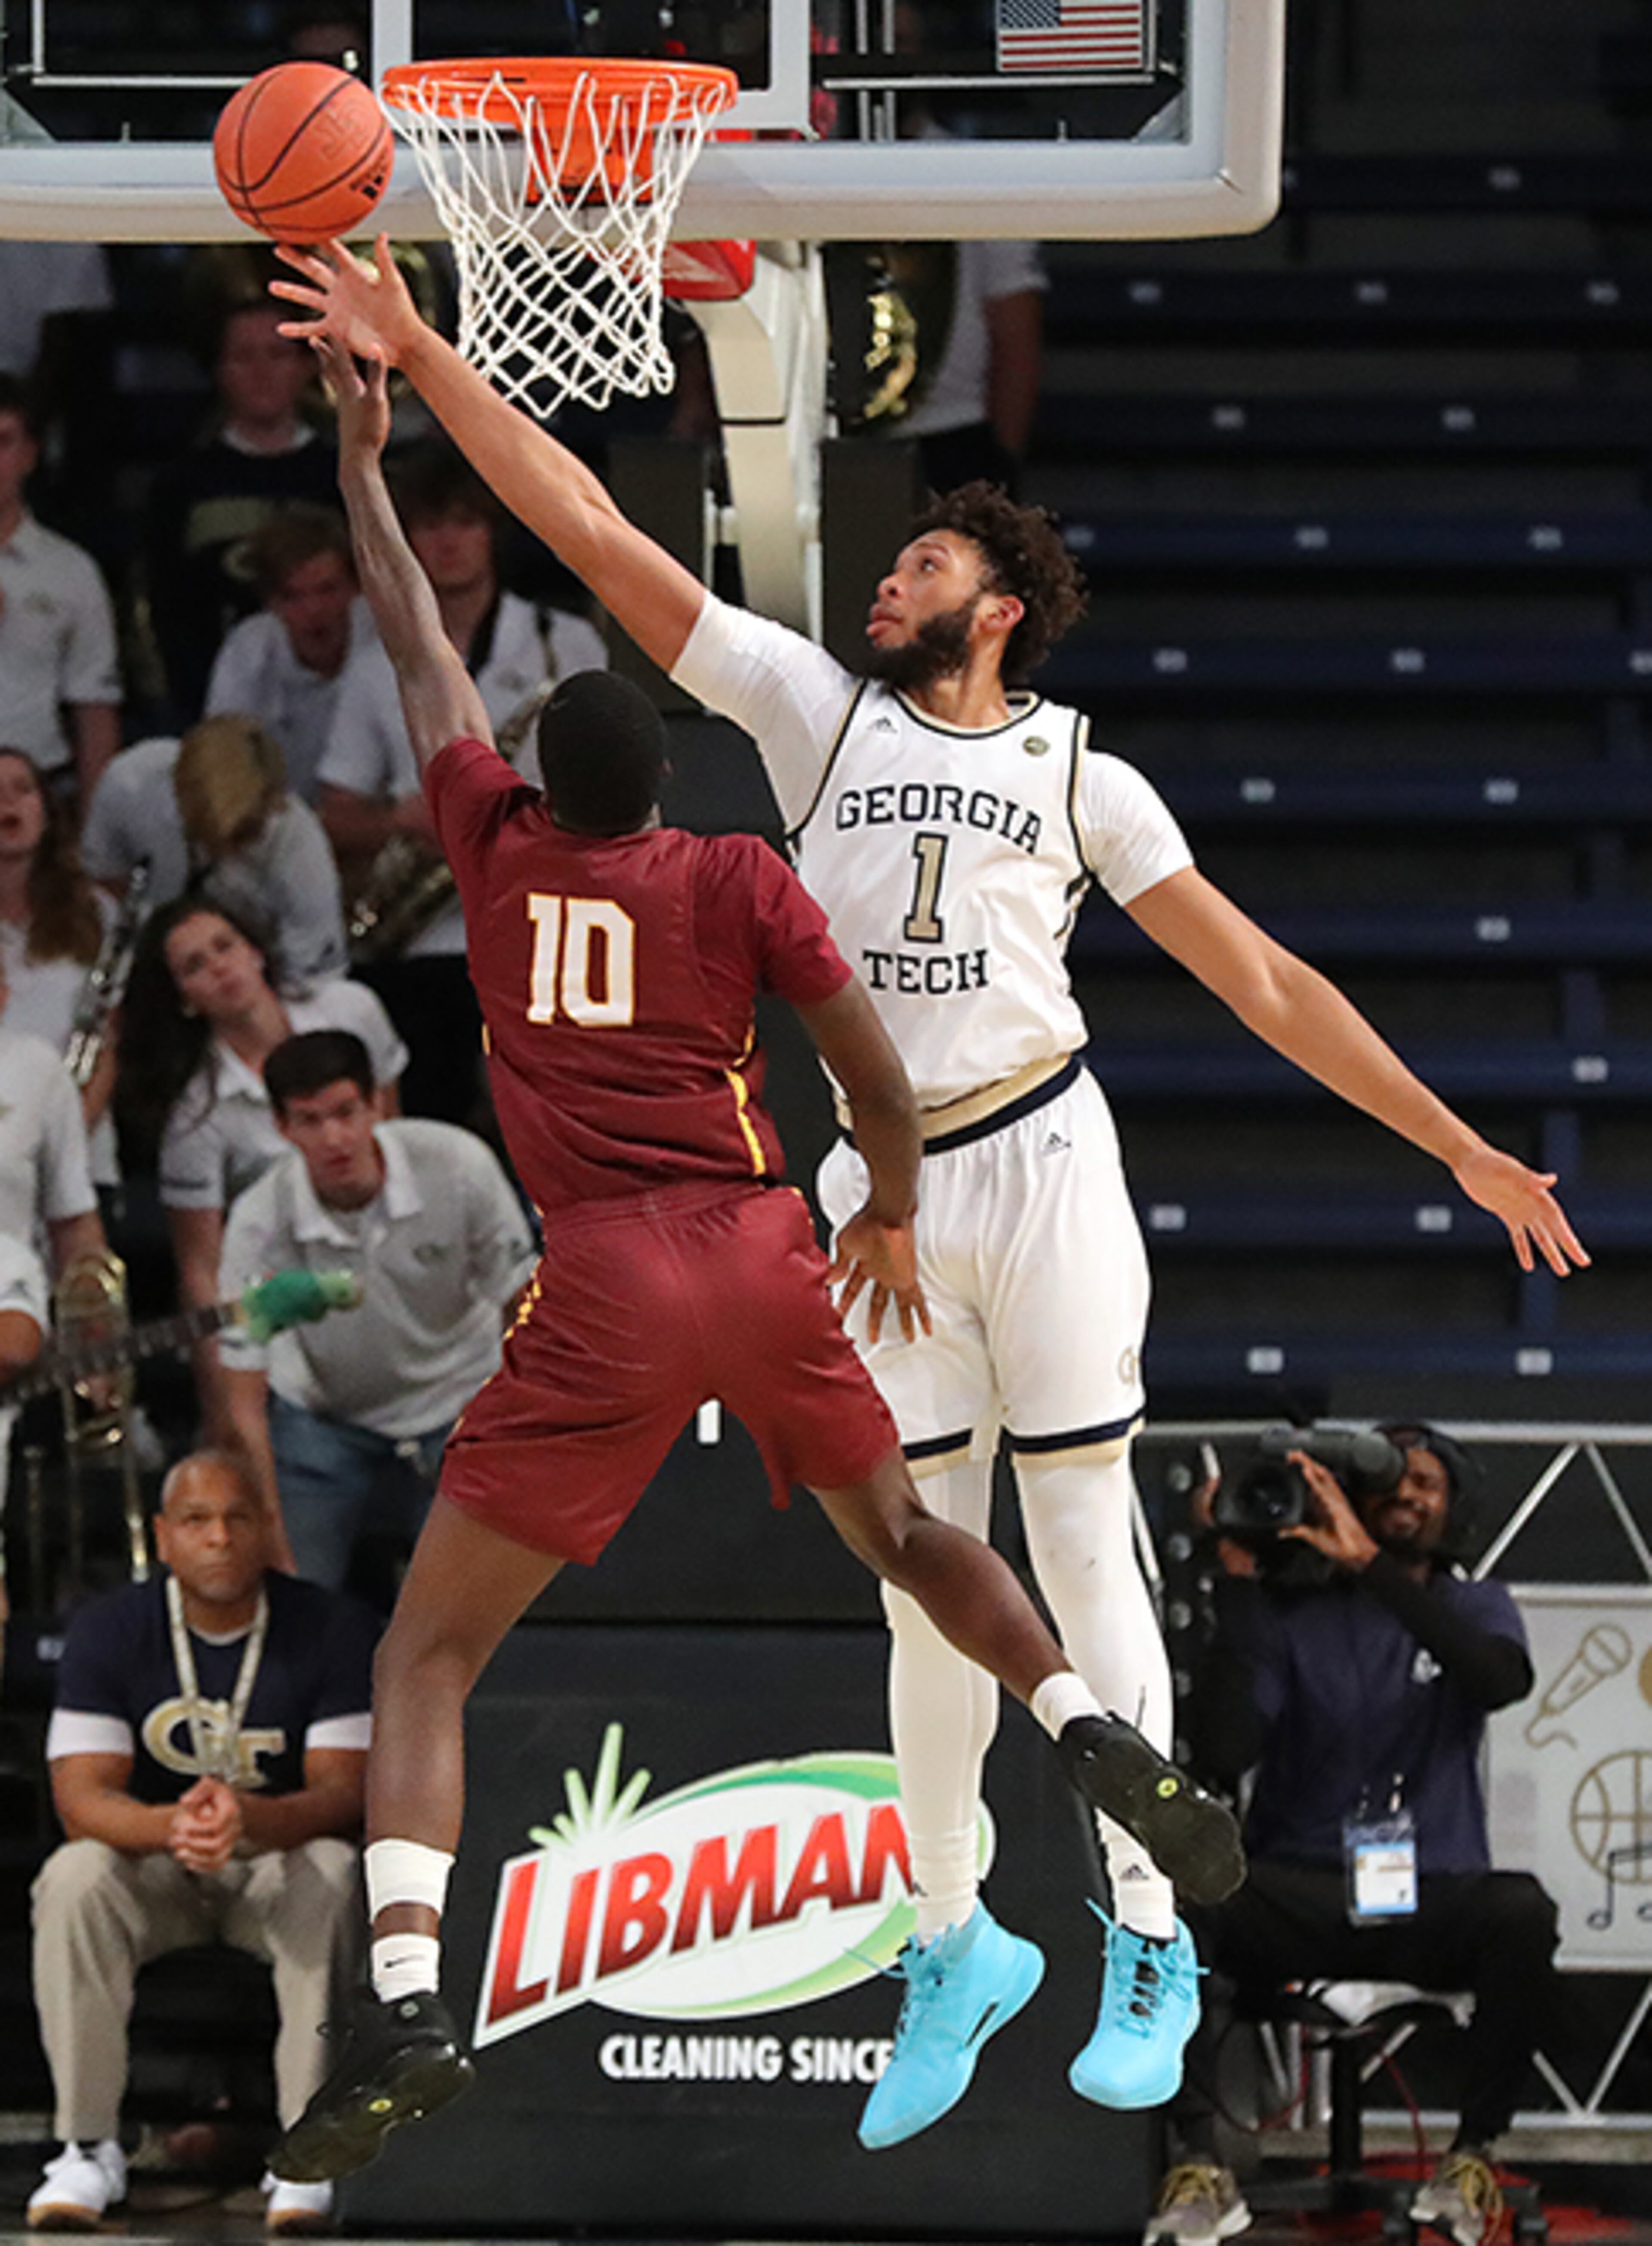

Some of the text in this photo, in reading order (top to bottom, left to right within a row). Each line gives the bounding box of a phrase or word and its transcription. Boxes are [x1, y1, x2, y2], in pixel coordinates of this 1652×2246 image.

[836, 784, 1042, 855] GEORGIA
[903, 831, 949, 944] 1
[527, 892, 636, 1028] 10
[862, 949, 989, 995] TECH
[601, 2034, 783, 2081] CLEANING
